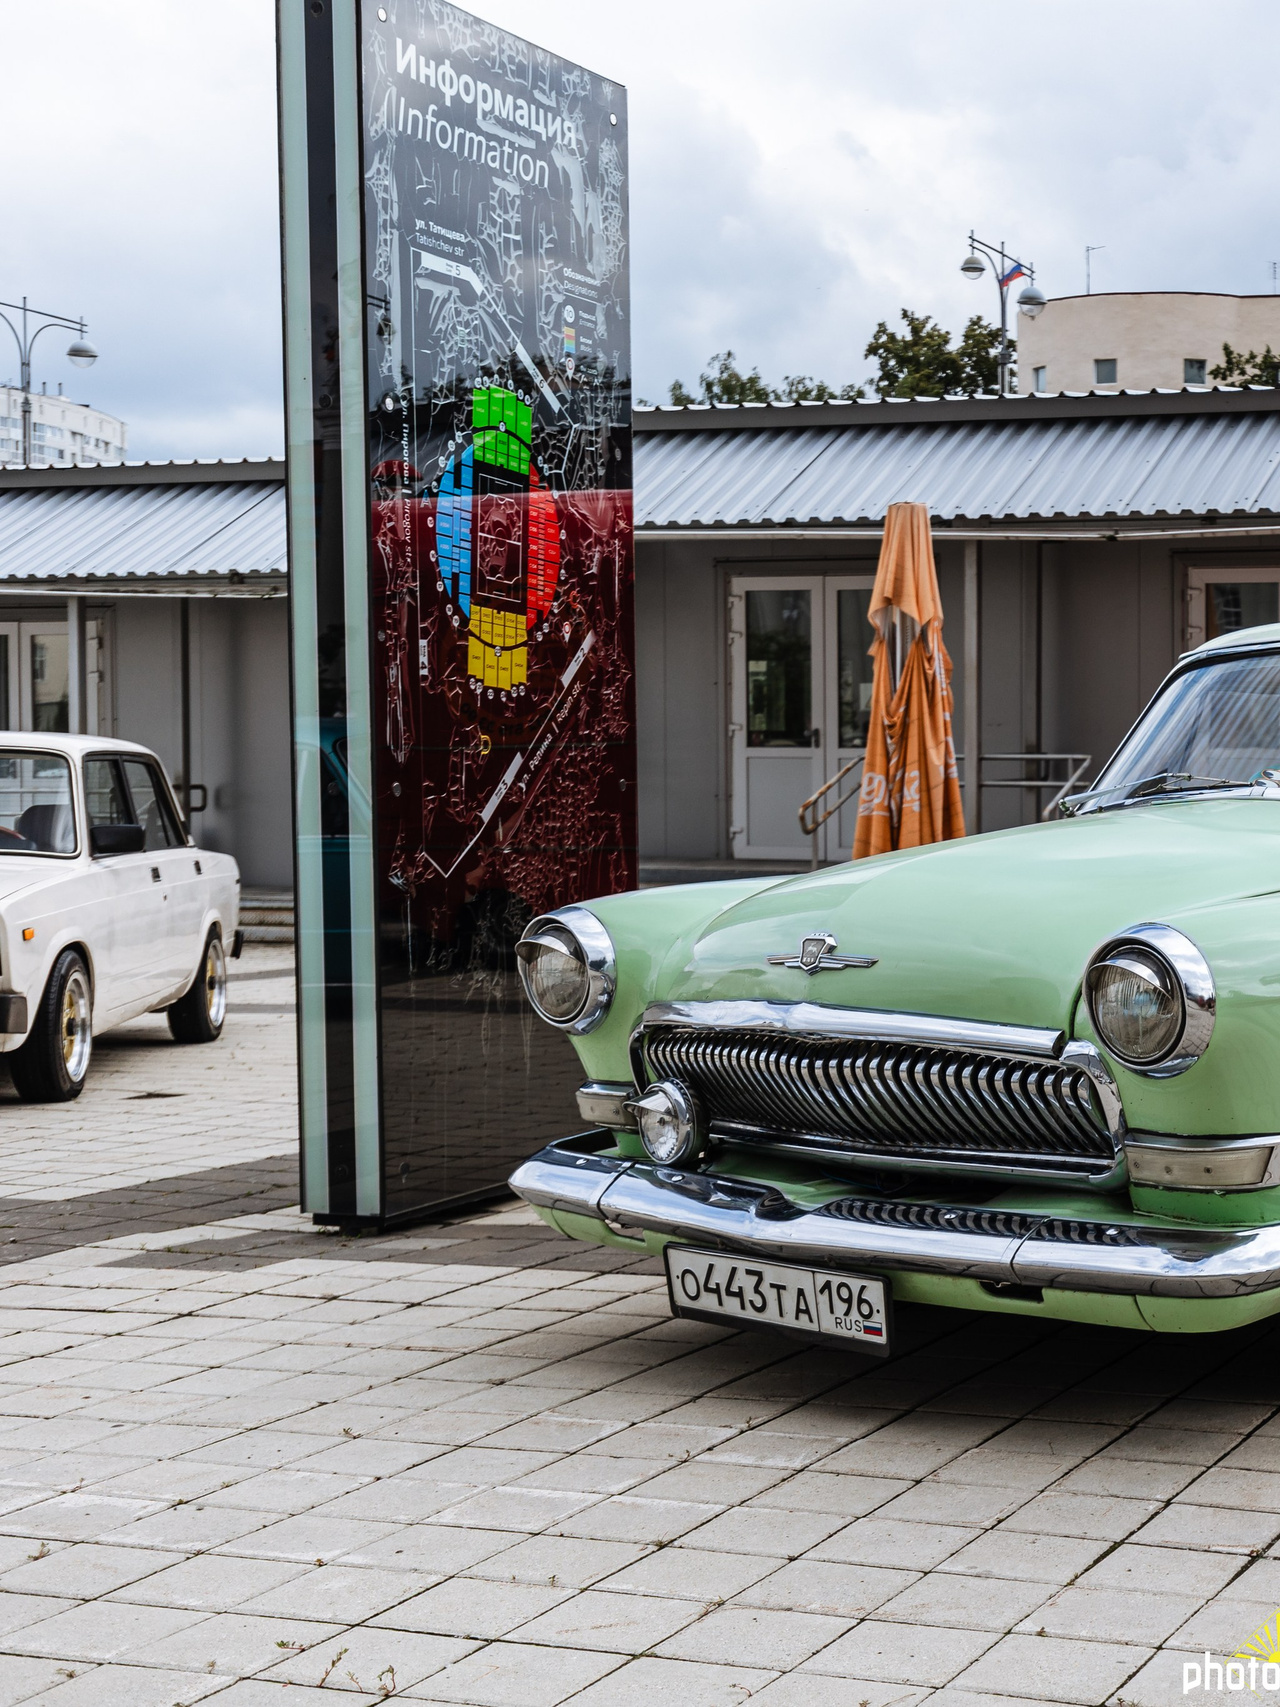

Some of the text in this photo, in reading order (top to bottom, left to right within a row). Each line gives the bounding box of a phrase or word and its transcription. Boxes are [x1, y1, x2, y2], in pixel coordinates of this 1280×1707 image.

[396, 37, 577, 150] Информация
[398, 97, 550, 188] Information
[455, 264, 462, 277] 5
[818, 1279, 874, 1321] 196
[834, 1316, 863, 1333] RUS
